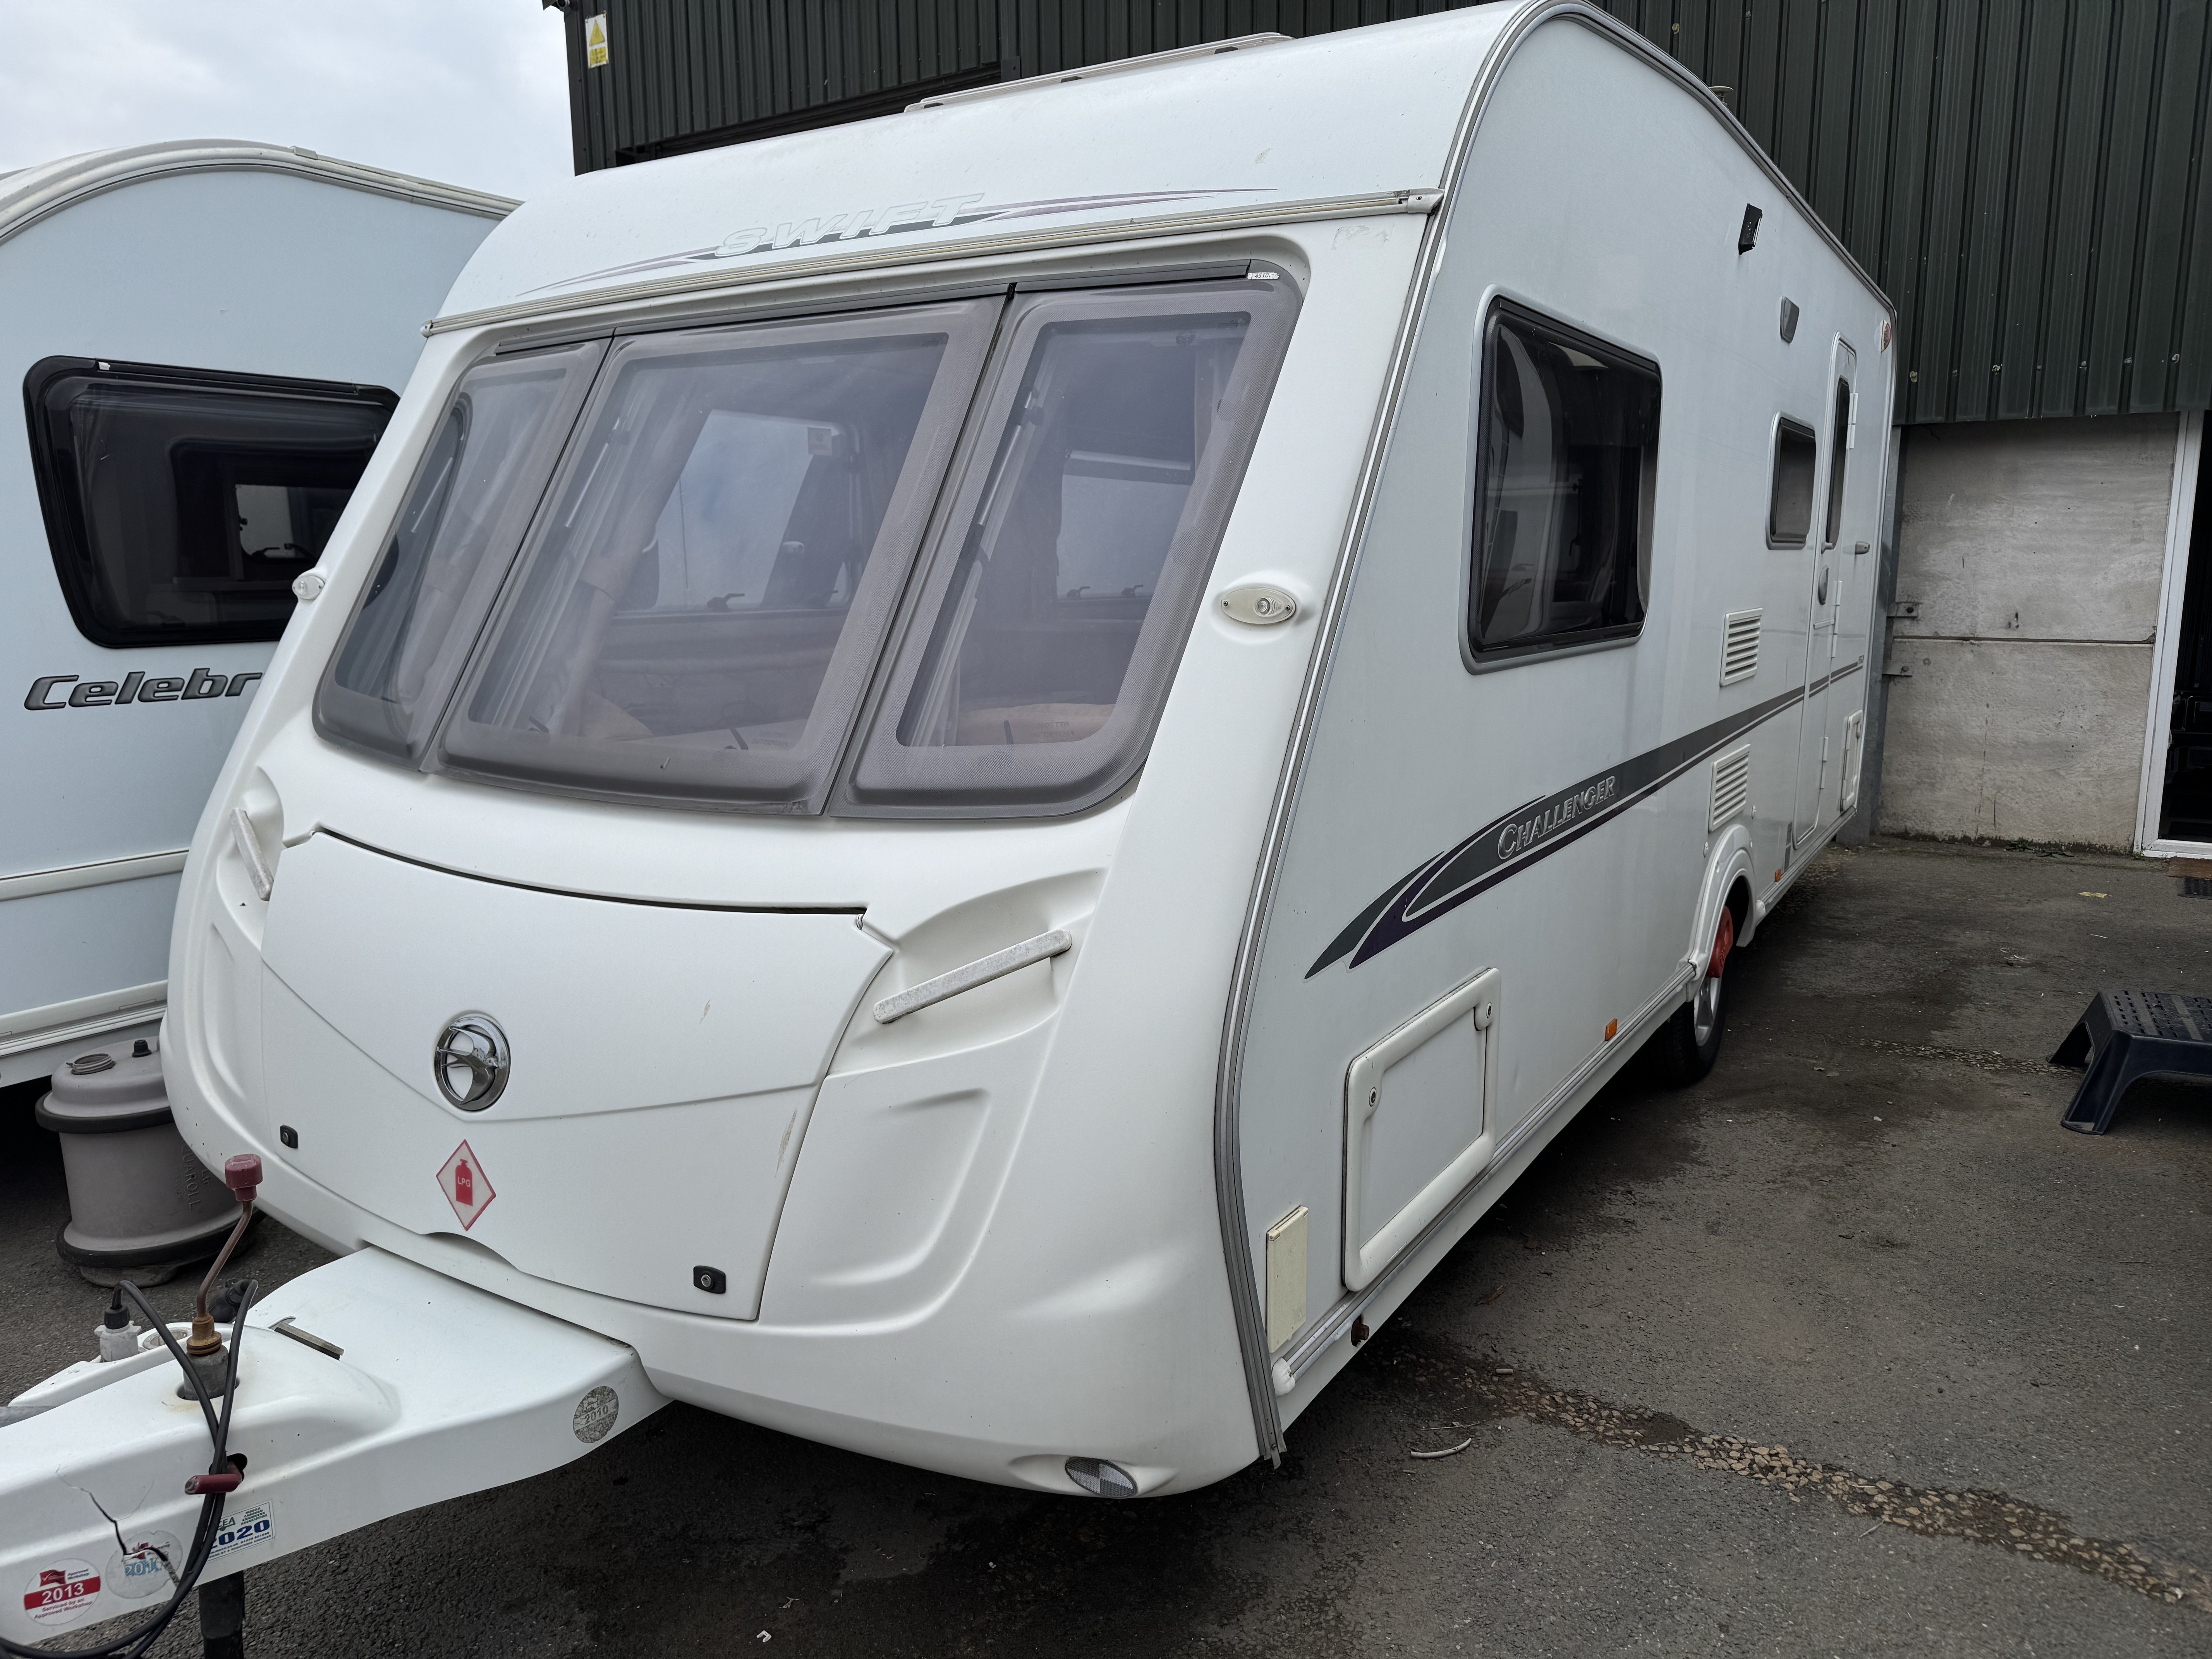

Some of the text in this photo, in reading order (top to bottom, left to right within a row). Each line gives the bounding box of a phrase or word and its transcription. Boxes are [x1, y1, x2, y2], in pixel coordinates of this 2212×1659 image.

[714, 193, 985, 257] SWIFT
[24, 668, 263, 711] Celebr
[1498, 776, 1615, 860] CHALLENGER
[457, 1176, 471, 1187] LPG
[585, 1404, 608, 1424] 2010
[244, 1509, 263, 1518] CARAVAN
[42, 1582, 84, 1604] 2013
[34, 1608, 62, 1620] Approved
